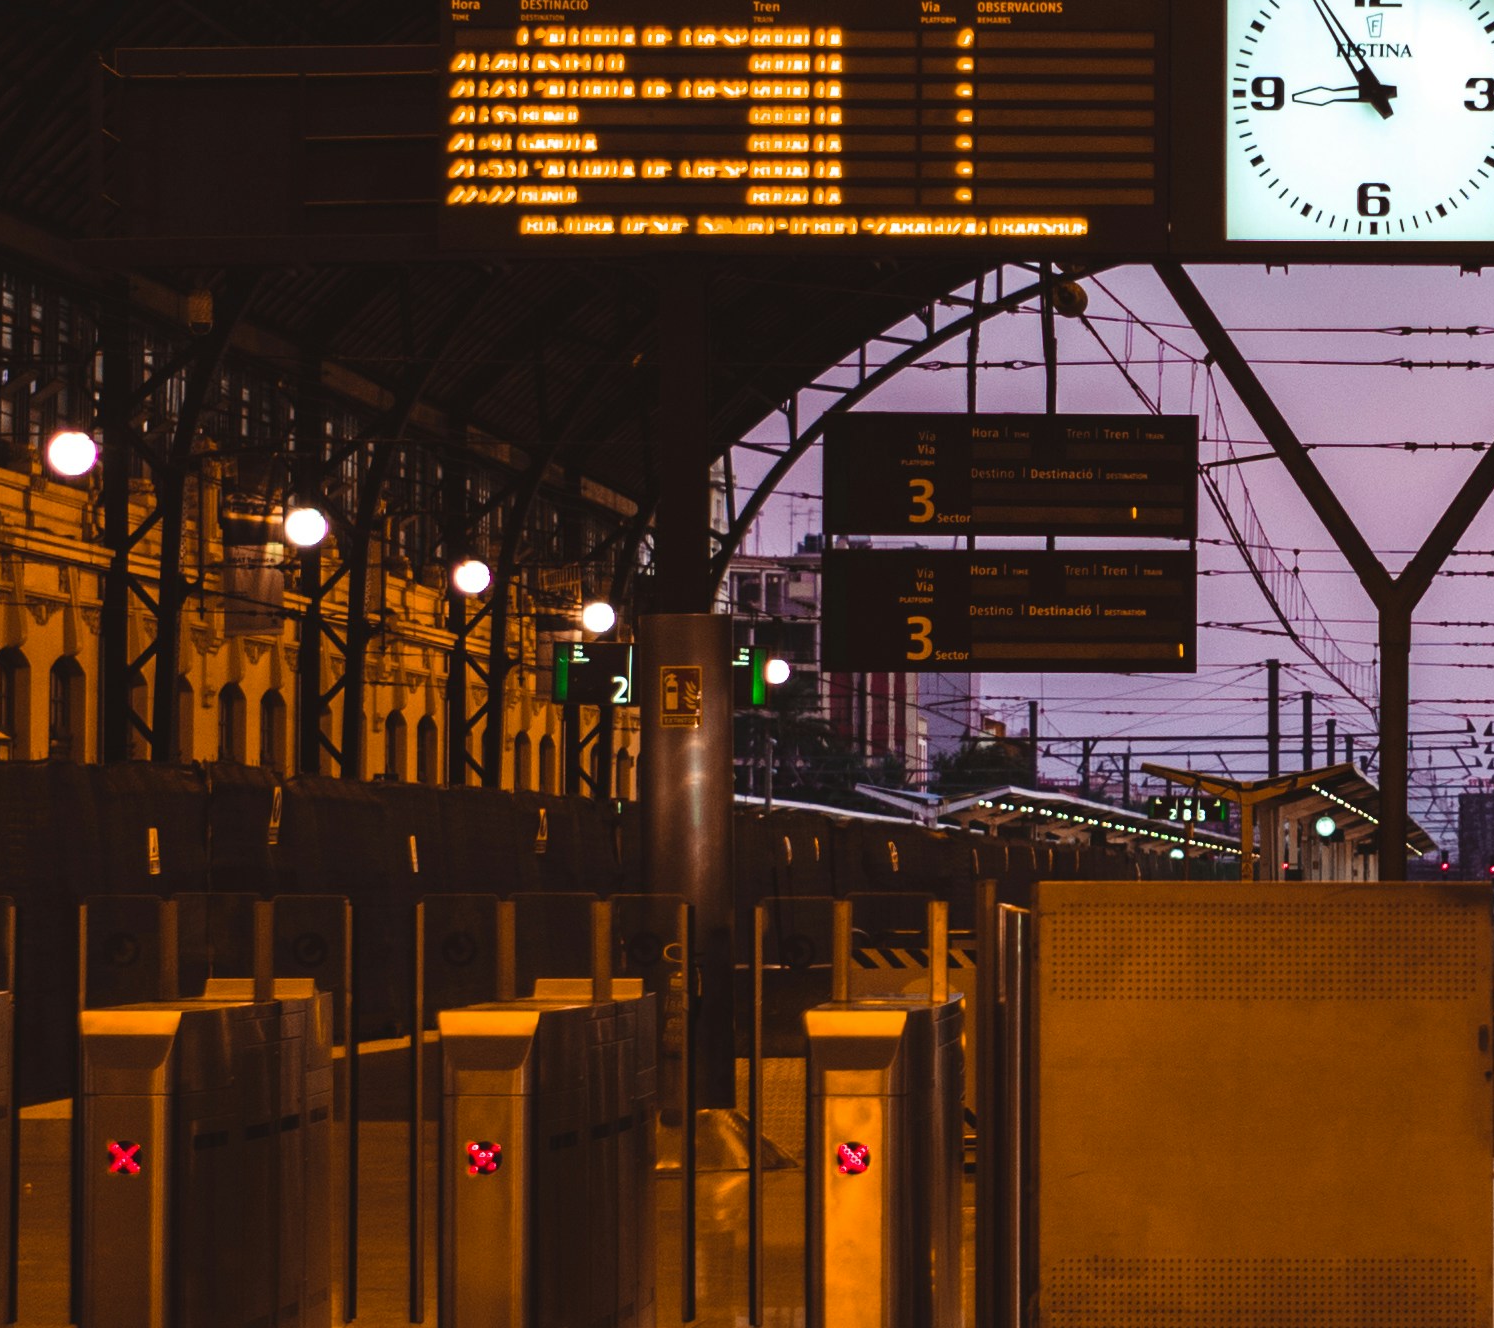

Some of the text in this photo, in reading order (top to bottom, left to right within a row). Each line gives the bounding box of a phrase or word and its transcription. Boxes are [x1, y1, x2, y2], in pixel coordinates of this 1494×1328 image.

[451, 0, 482, 10] Hora
[752, 1, 781, 13] Tren
[977, 1, 1064, 13] OBSERVACIONS
[1335, 42, 1414, 59] FESTINA
[1250, 76, 1285, 111] 9
[1356, 182, 1391, 217] 6
[971, 427, 999, 438] Hora
[1066, 428, 1129, 439] Tren Tren
[970, 468, 1015, 479] Destino
[1030, 467, 1093, 480] Destinació
[908, 477, 971, 524] 3 Sector
[970, 565, 998, 576] Hora
[1065, 565, 1128, 576] Tren Tren
[969, 605, 1014, 616] Destino
[1029, 604, 1092, 617] Destinació
[905, 615, 969, 661] 3 Sector
[611, 675, 630, 704] 2
[1168, 808, 1179, 821] 2
